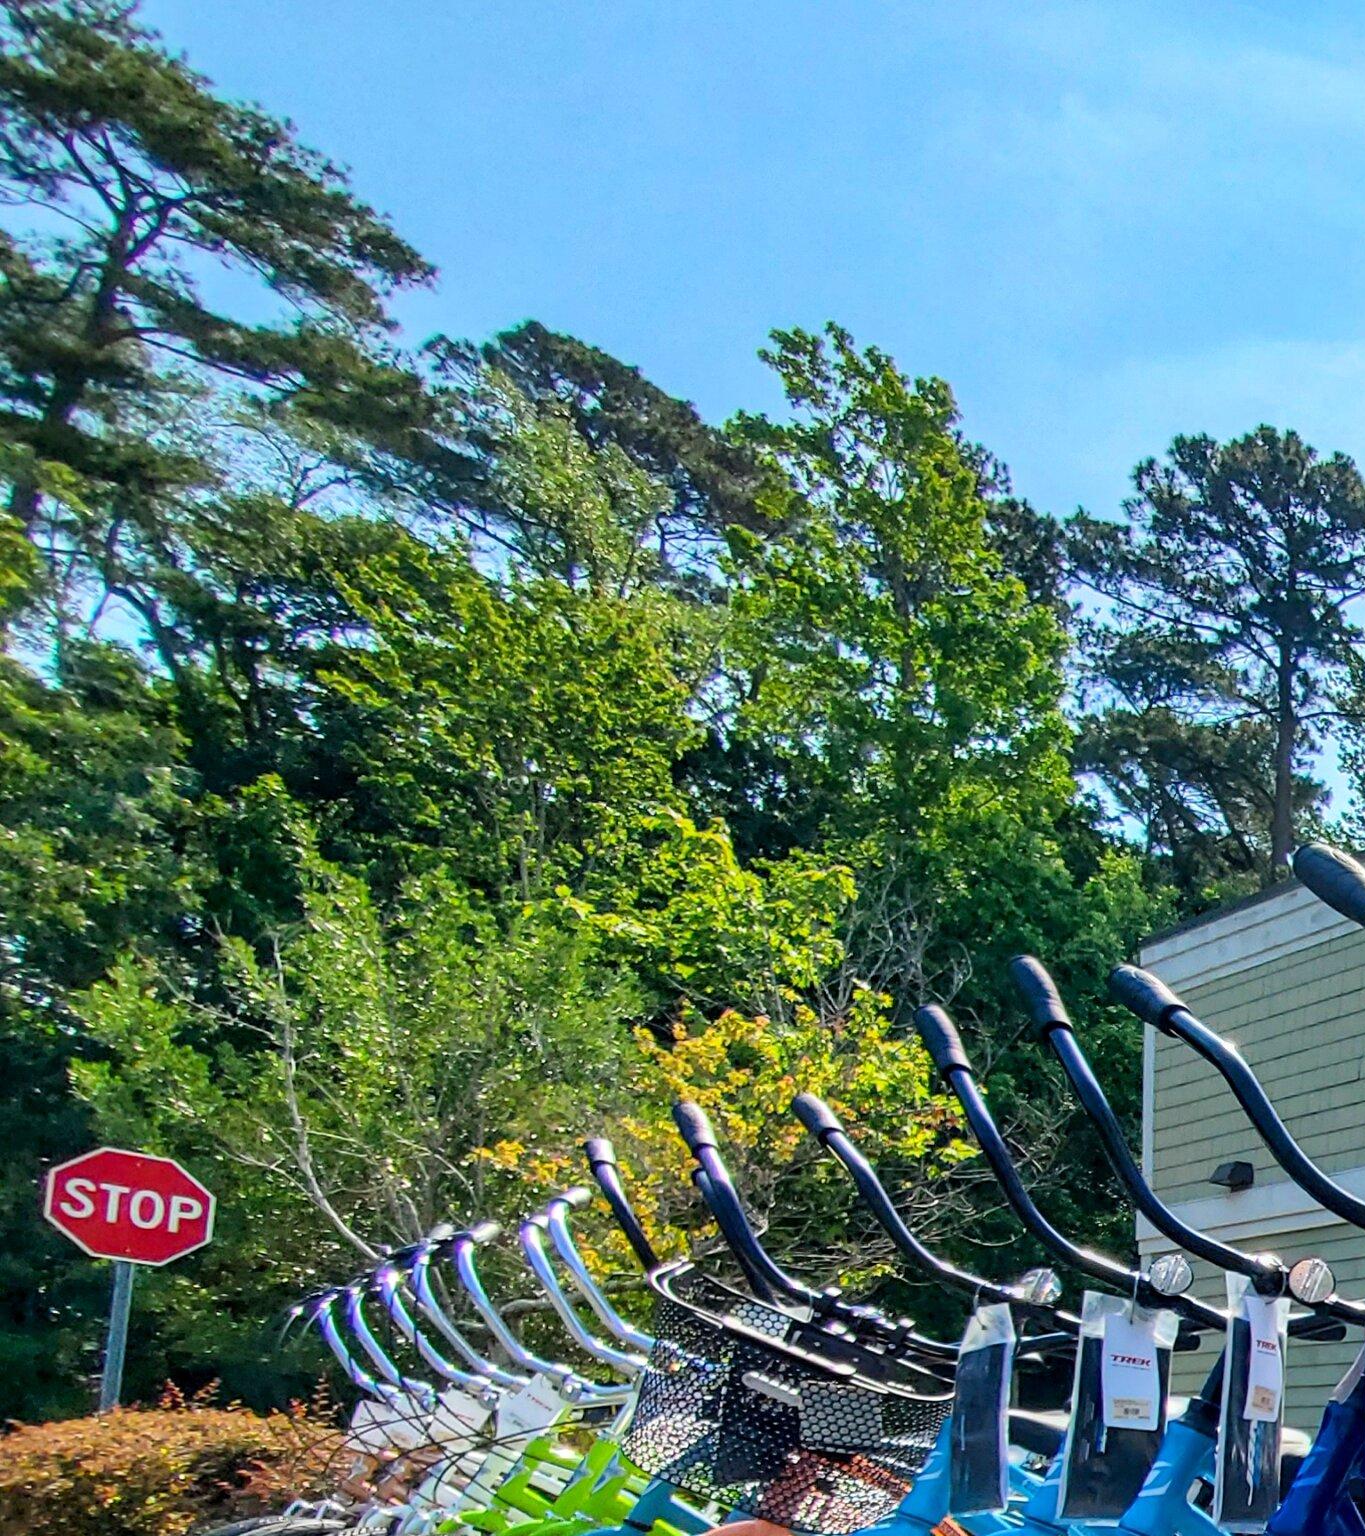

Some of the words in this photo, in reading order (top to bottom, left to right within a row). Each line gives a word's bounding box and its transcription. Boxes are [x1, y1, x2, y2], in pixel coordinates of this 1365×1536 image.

[59, 1176, 204, 1235] STOP
[1255, 1339, 1277, 1351] TREK
[1110, 1354, 1151, 1367] TREK
